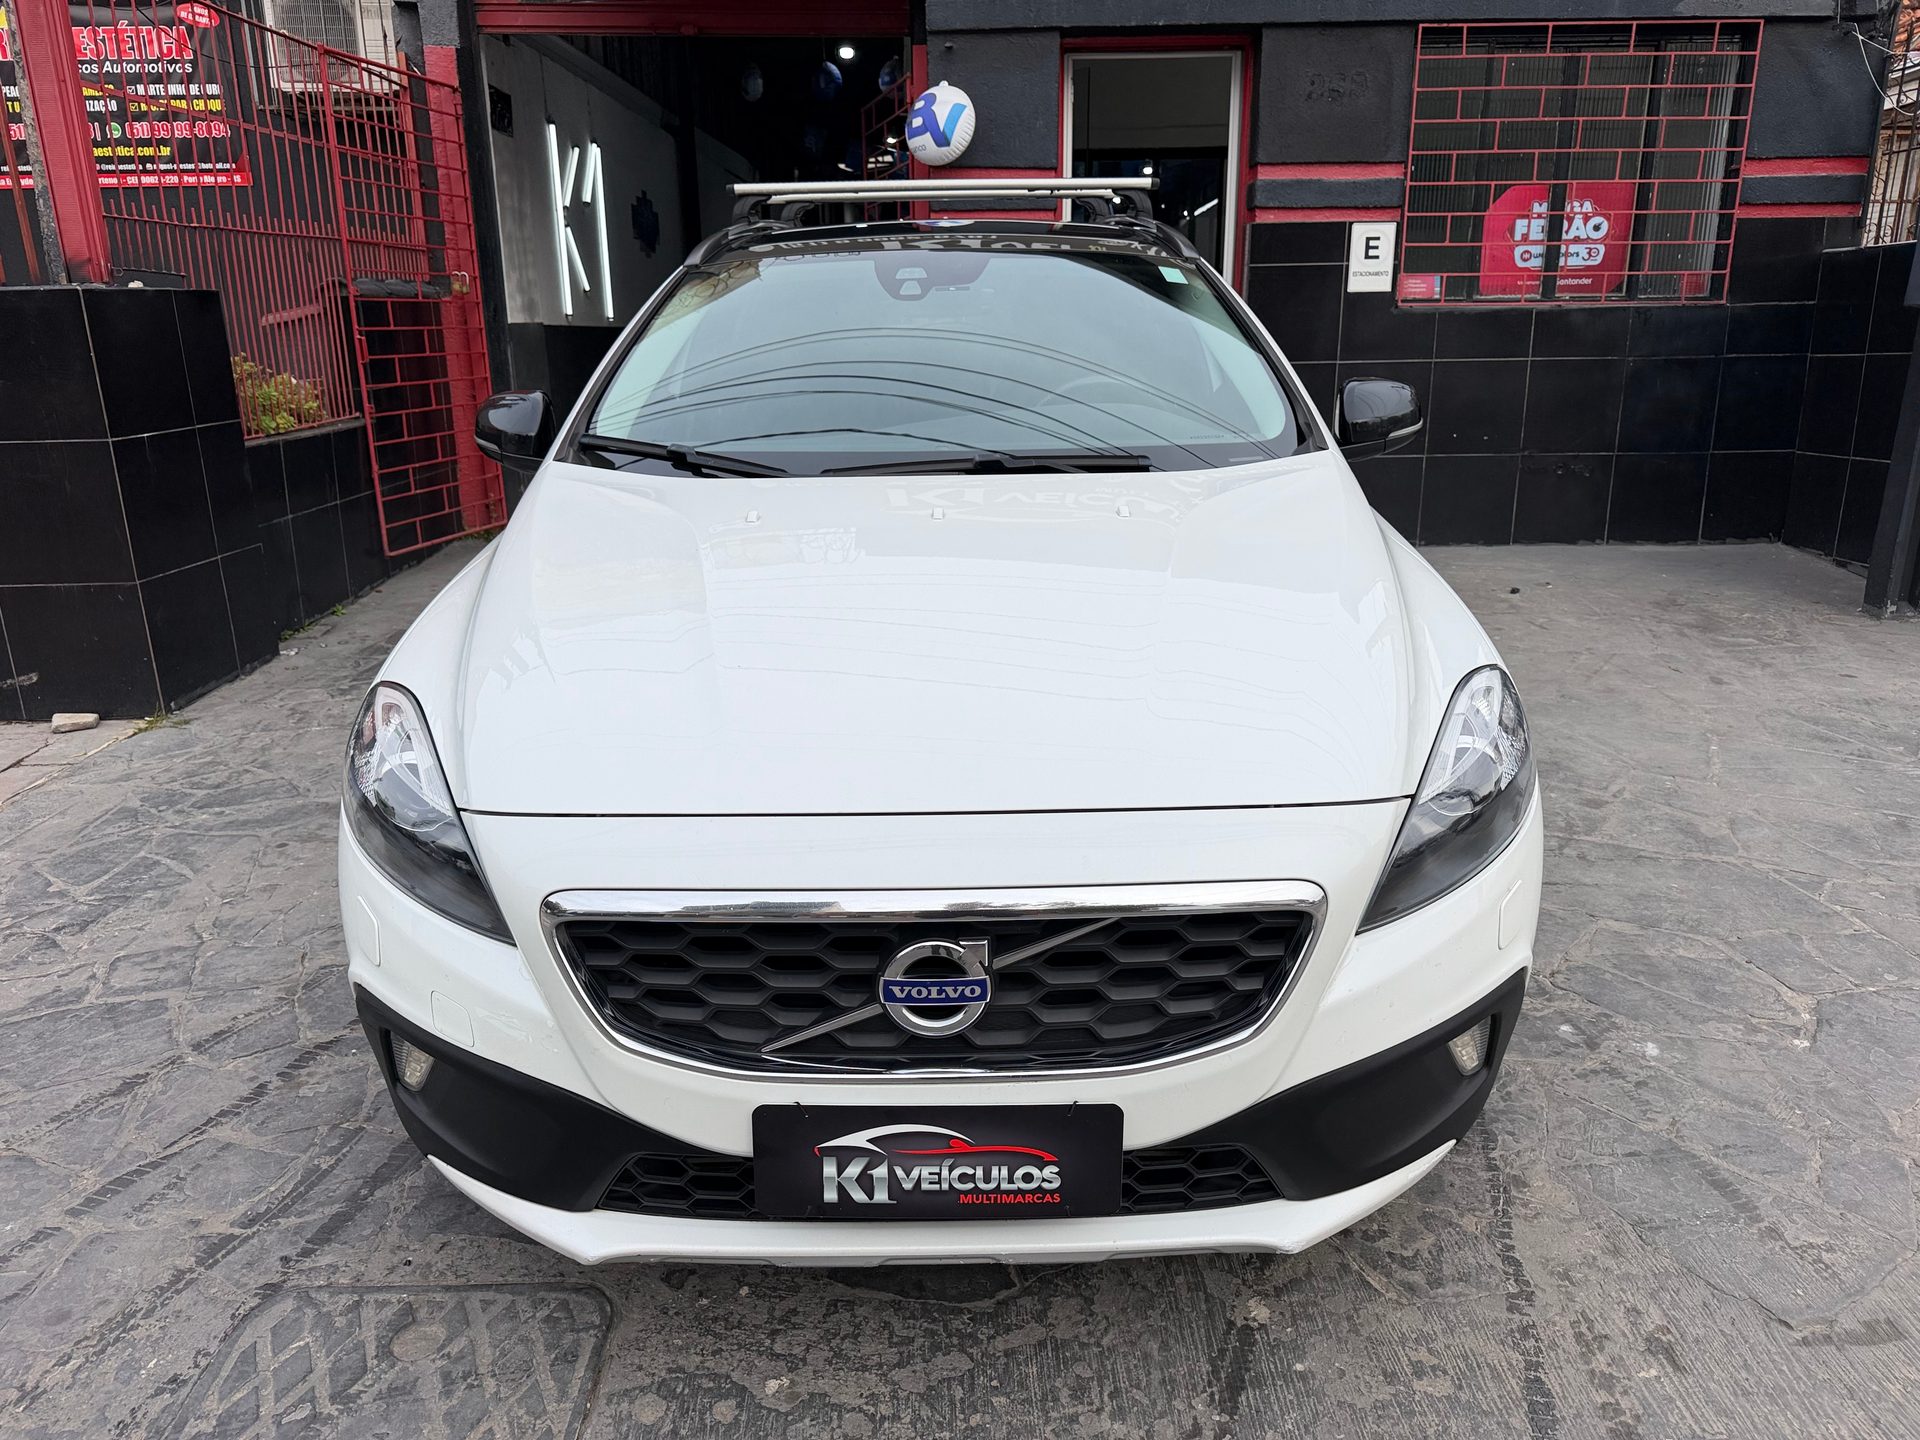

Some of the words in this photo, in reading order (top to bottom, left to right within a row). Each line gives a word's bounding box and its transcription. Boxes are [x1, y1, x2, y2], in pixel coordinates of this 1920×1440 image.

[72, 20, 194, 60] ESTÉTICA
[1364, 236, 1381, 260] E
[889, 985, 981, 998] VOLVO
[823, 1156, 897, 1204] K1
[893, 1158, 1062, 1191] VEÍCULOS
[960, 1193, 1061, 1204] MULTIMARCAS
